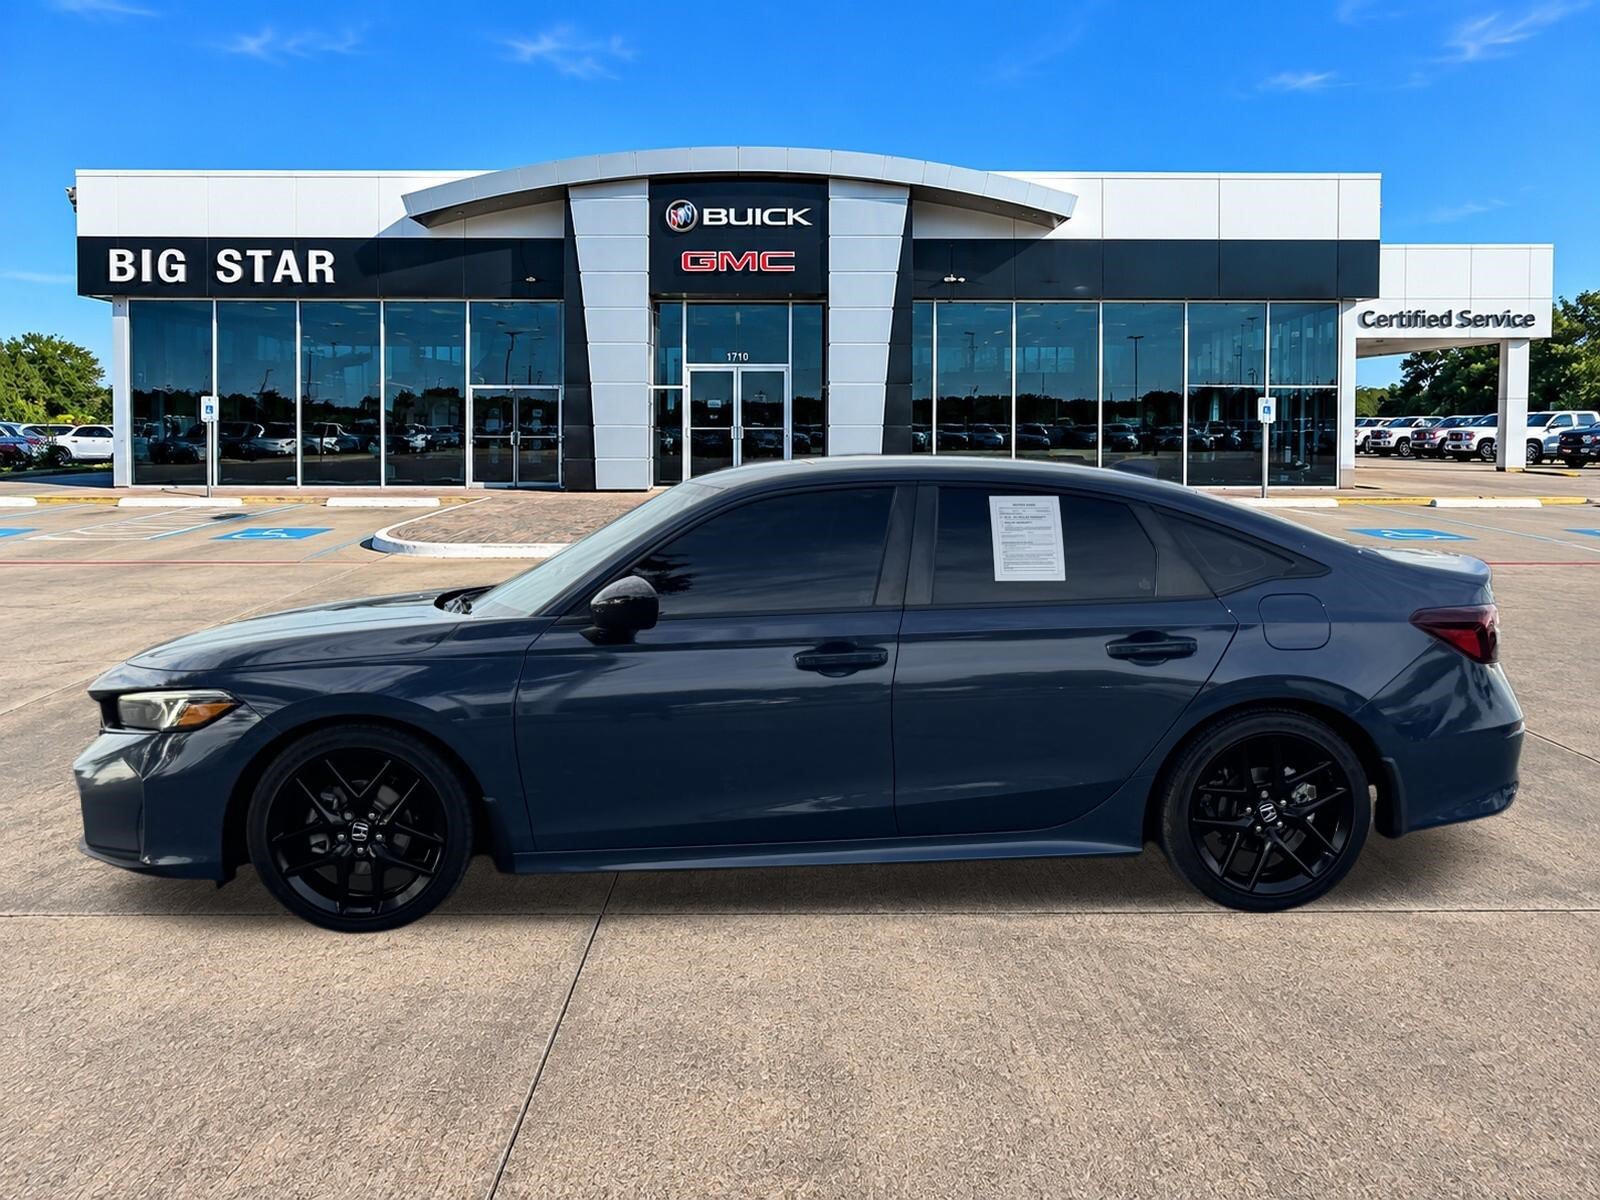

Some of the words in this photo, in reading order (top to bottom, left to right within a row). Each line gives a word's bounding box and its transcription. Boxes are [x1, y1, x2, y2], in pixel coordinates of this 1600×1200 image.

[702, 207, 813, 226] BUICK
[108, 248, 187, 283] BIG
[216, 248, 336, 284] STAR
[681, 250, 796, 272] GMC
[1359, 309, 1453, 328] Certified
[1457, 309, 1536, 328] Service
[727, 351, 749, 361] 1710
